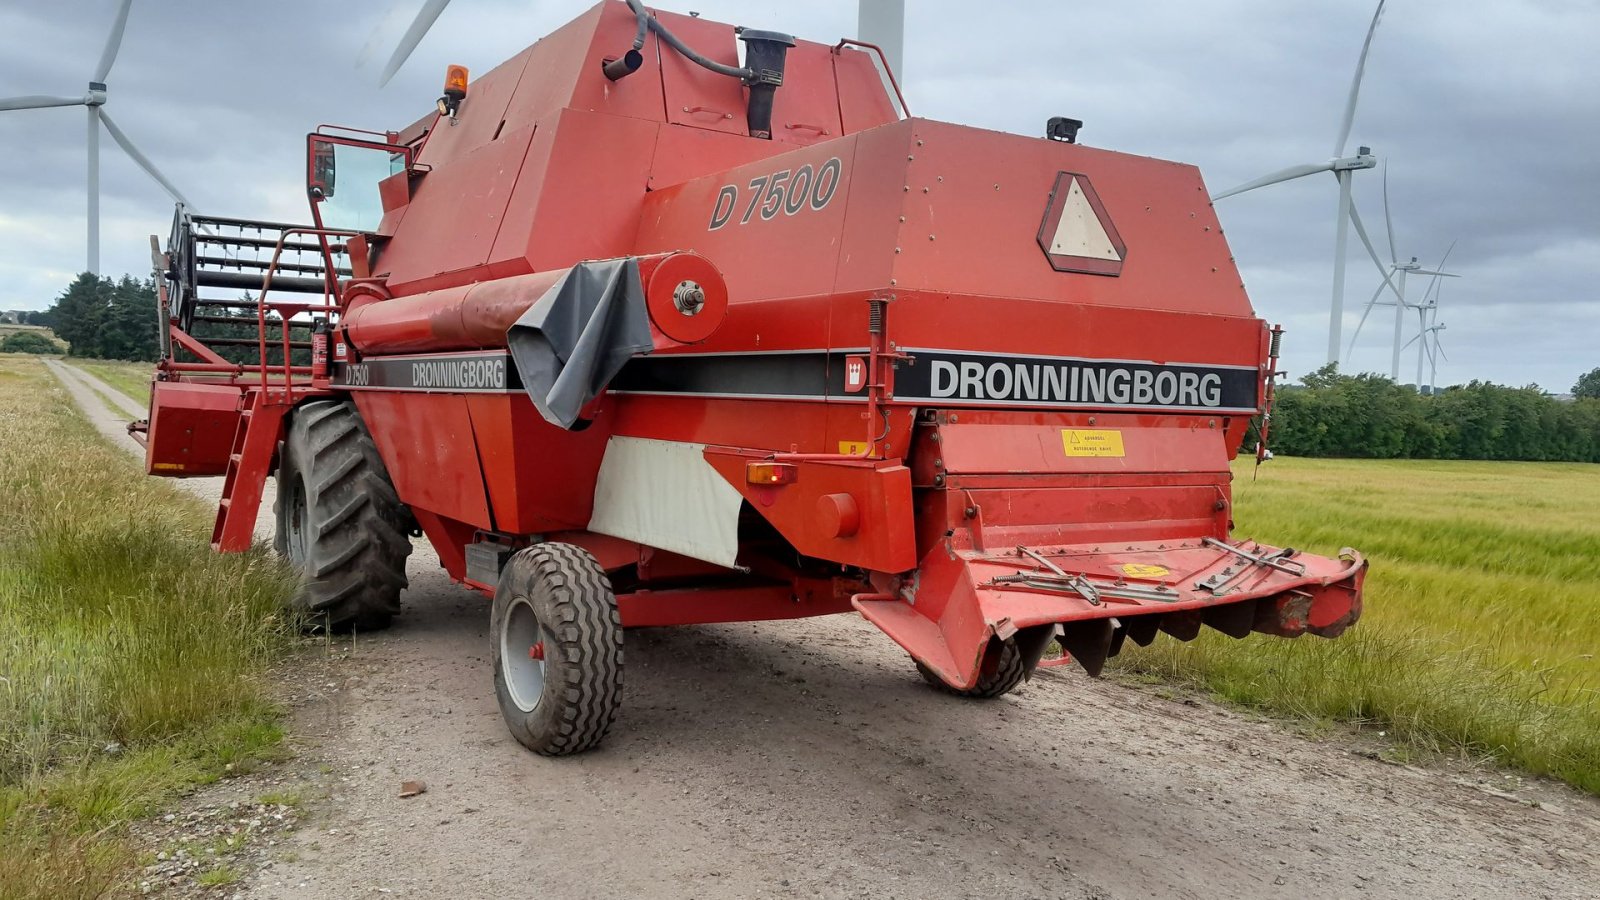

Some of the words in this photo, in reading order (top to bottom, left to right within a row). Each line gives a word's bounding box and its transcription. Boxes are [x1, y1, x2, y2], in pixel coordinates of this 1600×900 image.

[708, 184, 738, 231] D
[740, 157, 842, 225] 7500
[345, 365, 352, 385] D
[352, 364, 369, 386] 7500
[412, 359, 504, 388] DRONNINGBORG
[930, 360, 1222, 407] DRONNINGBORG
